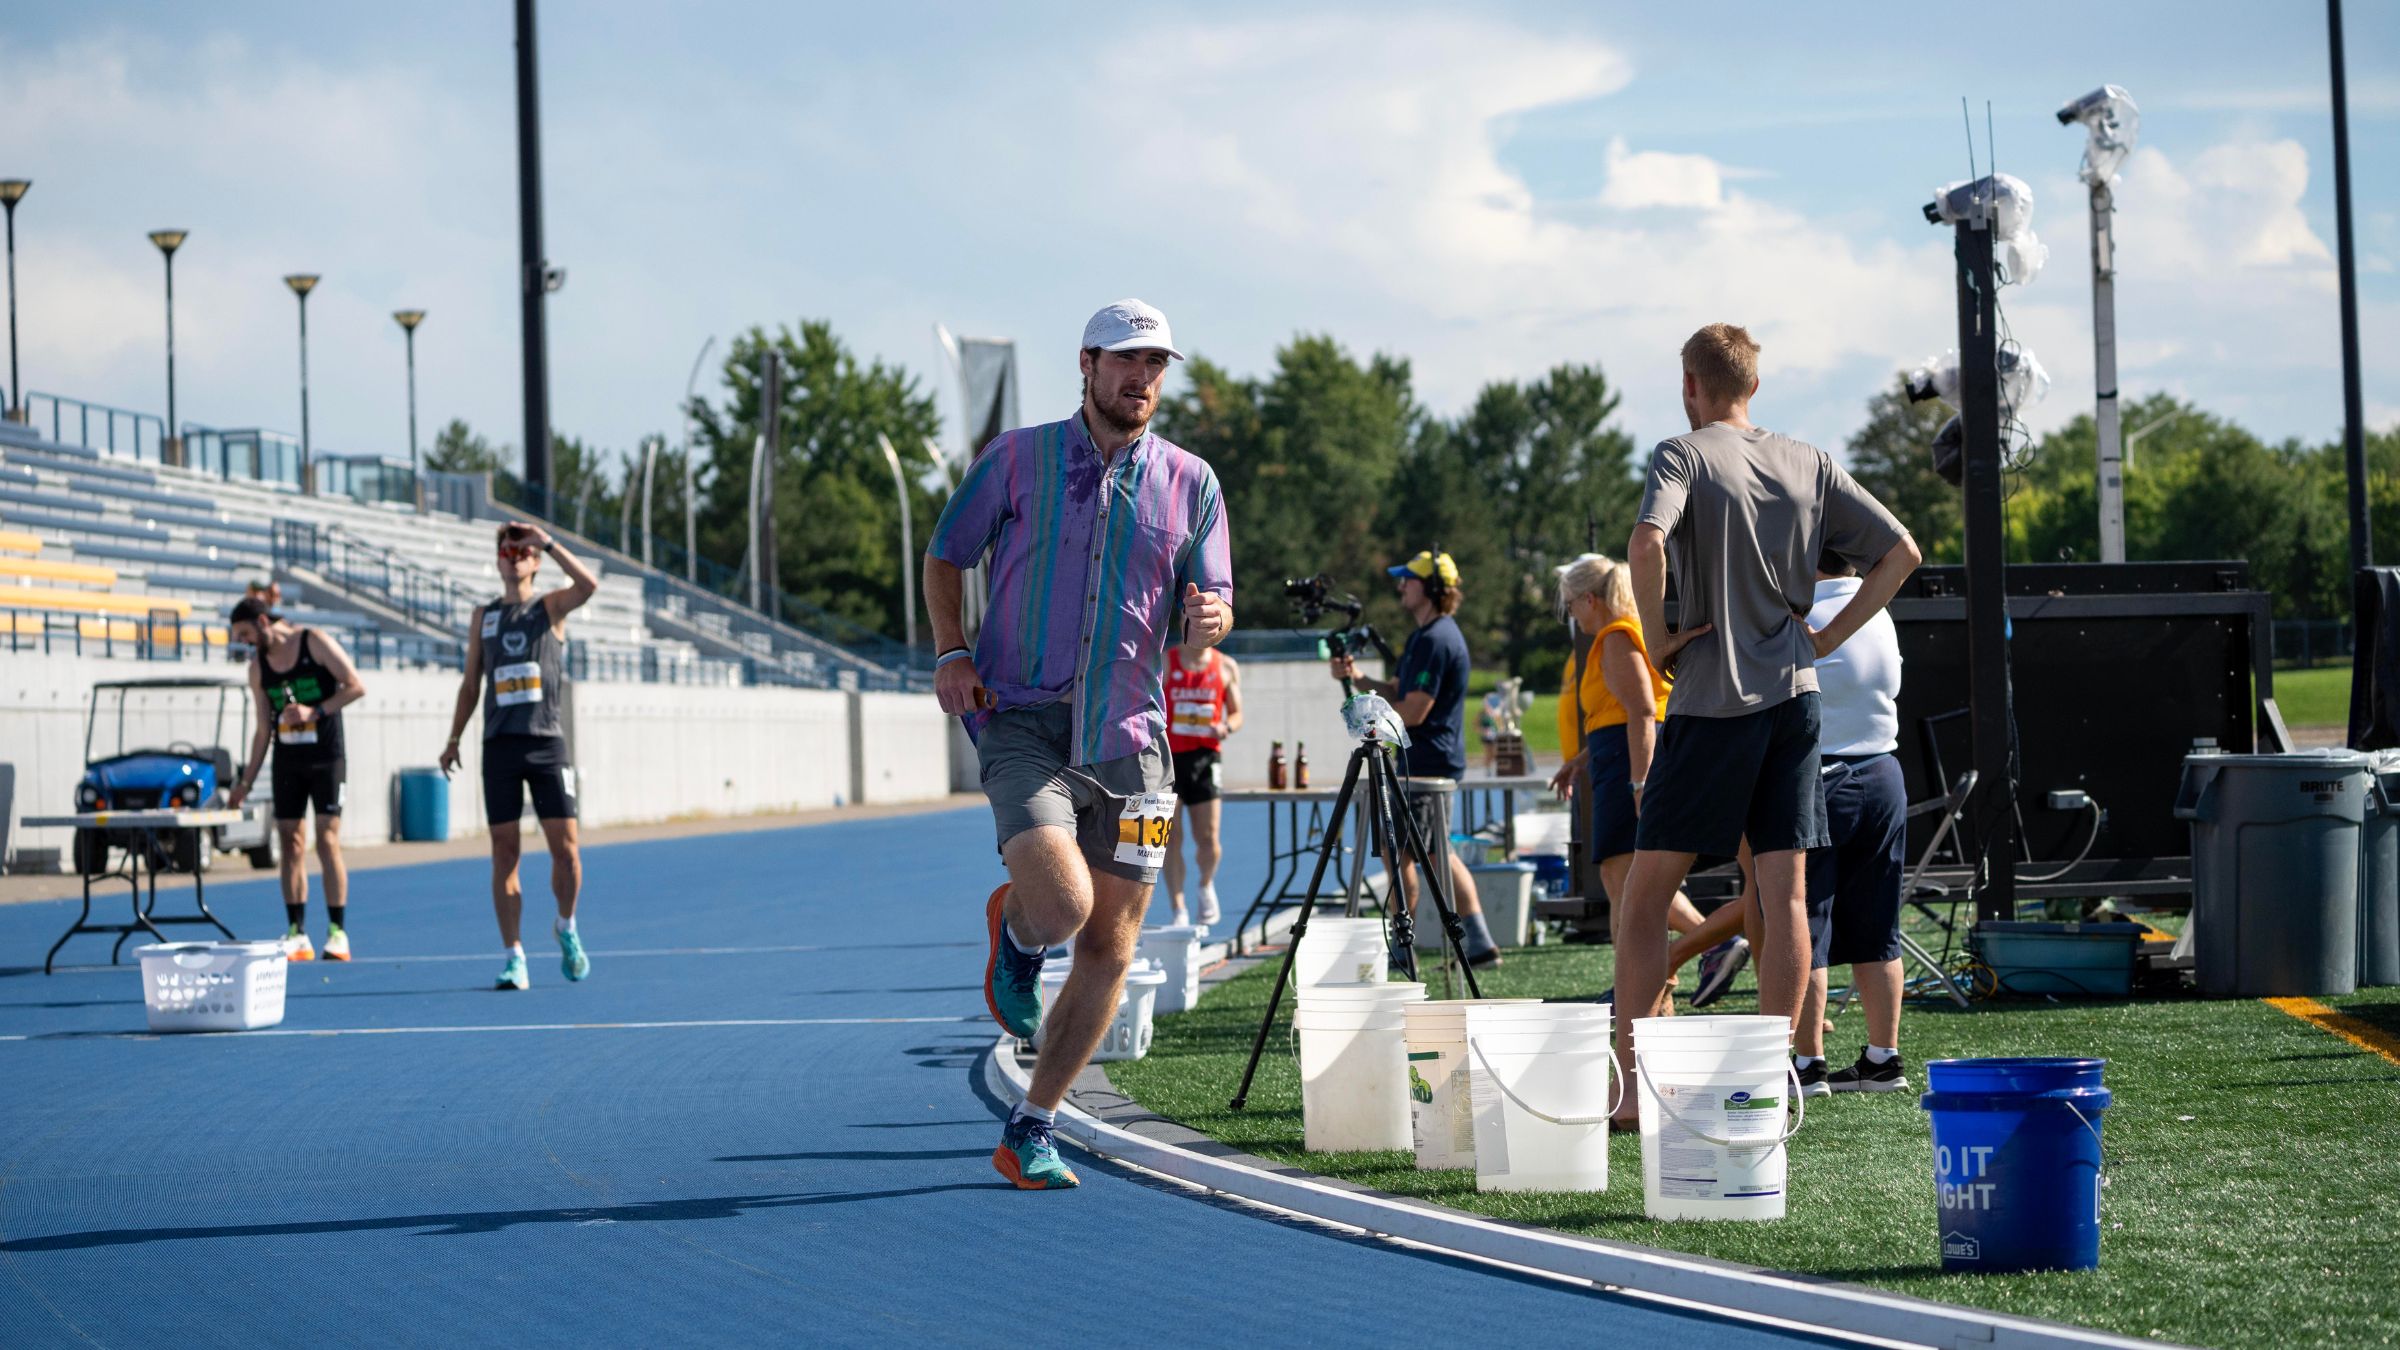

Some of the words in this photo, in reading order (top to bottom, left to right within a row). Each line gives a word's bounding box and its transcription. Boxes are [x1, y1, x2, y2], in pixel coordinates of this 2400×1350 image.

[1171, 687, 1216, 700] CANADA
[2300, 781, 2344, 792] BRUTE
[1134, 815, 1174, 847] 138
[1961, 1145, 1994, 1177] IT
[1936, 1182, 1996, 1210] IGHT
[1944, 1242, 1974, 1257] LOWE'S
